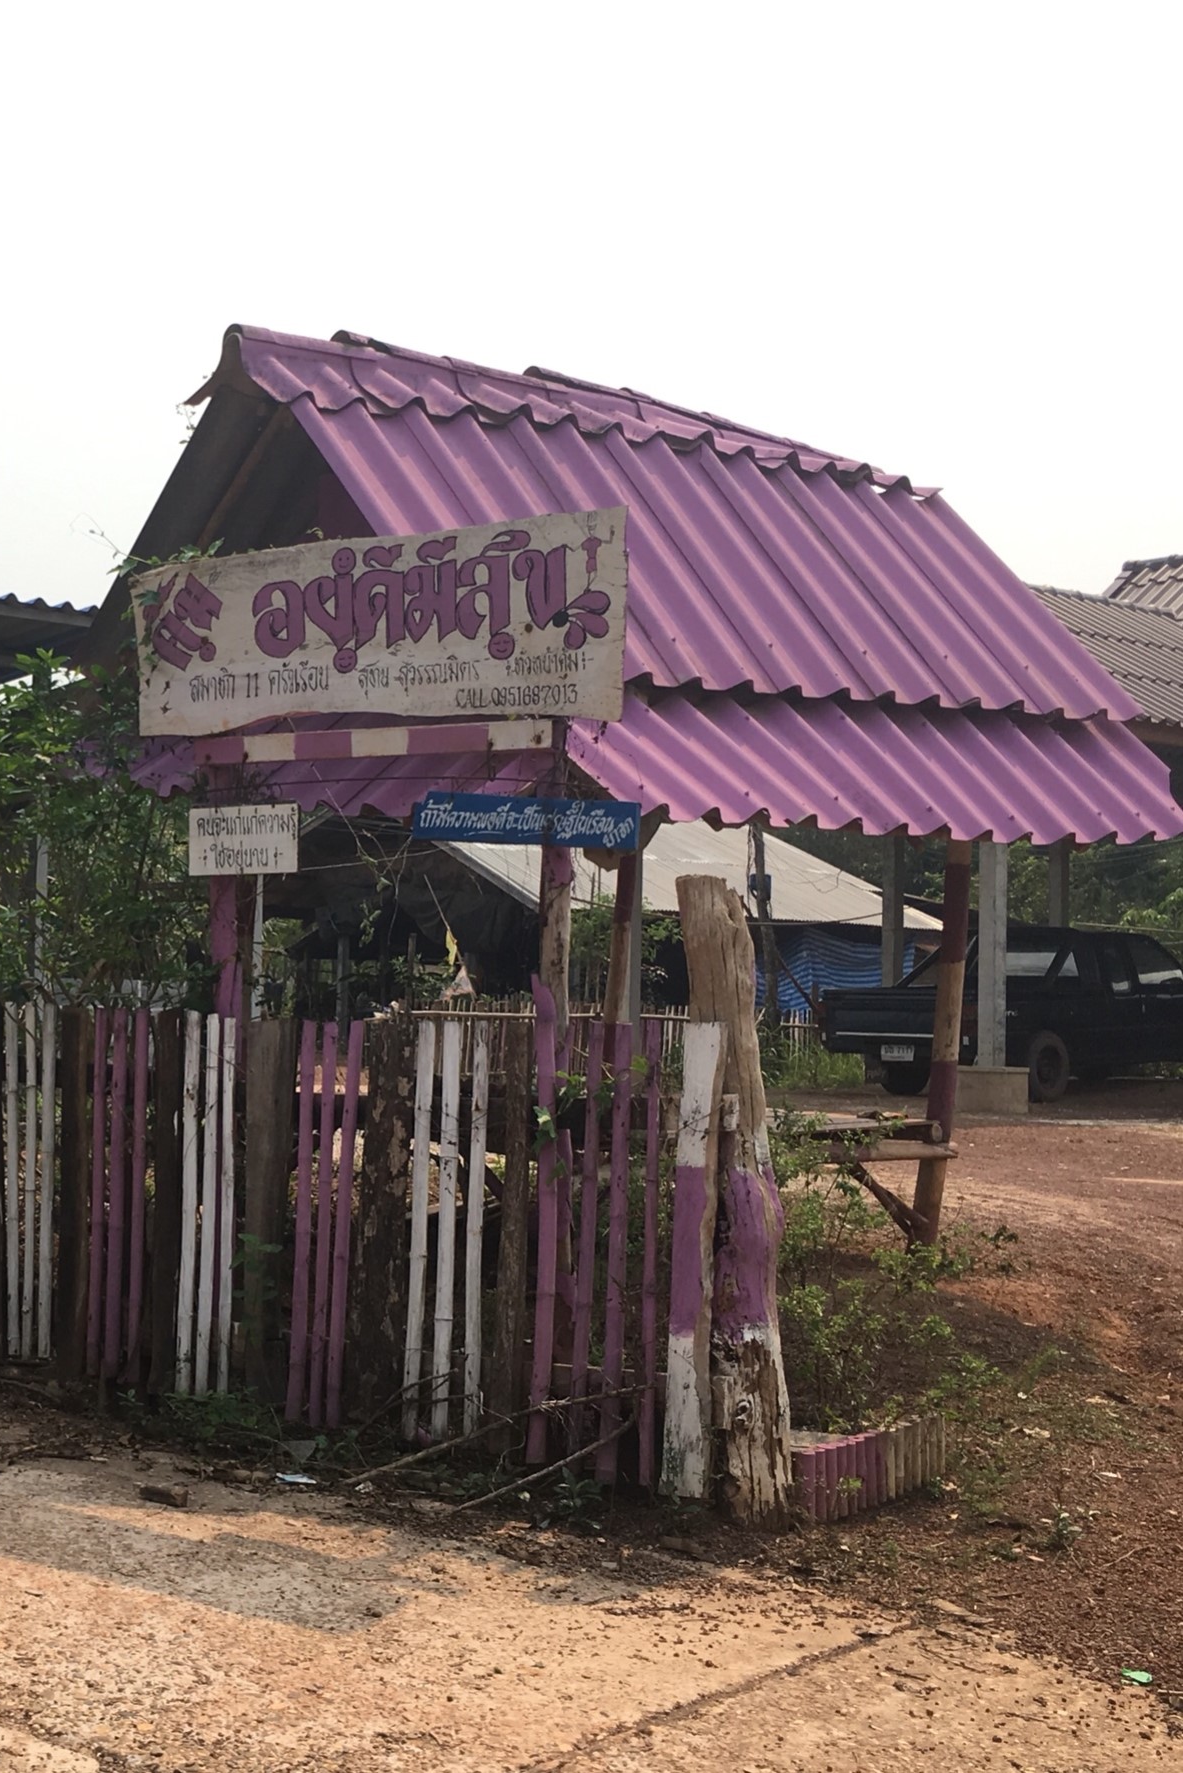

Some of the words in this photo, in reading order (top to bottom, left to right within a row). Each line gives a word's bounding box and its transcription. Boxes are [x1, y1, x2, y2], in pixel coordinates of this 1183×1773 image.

[252, 530, 571, 673] อยู่ดีมีสุข
[189, 667, 235, 702] สมาชิก
[245, 672, 260, 698] 11
[268, 660, 329, 695] ครัวเรือน
